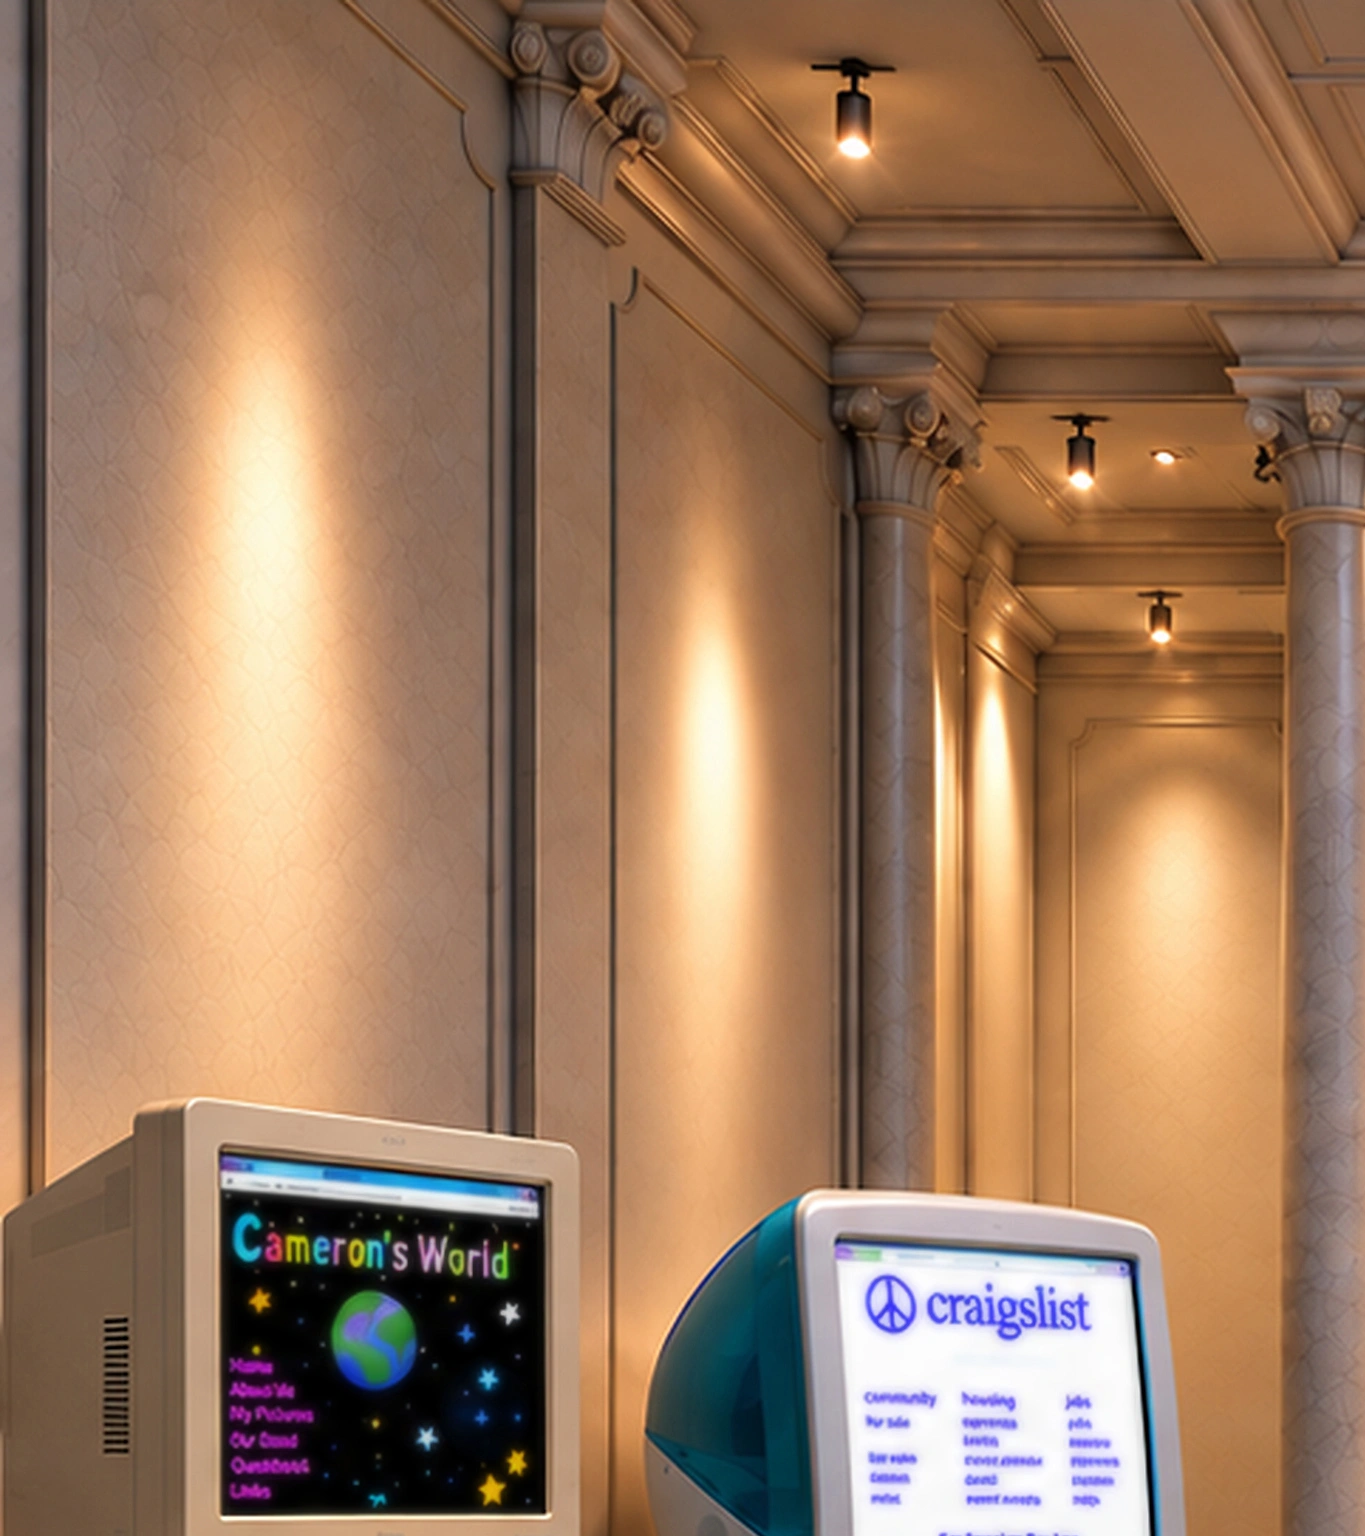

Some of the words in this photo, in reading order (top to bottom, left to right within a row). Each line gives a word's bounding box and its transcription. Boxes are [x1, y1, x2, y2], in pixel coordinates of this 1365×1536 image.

[232, 1213, 408, 1271] Cameron's
[418, 1234, 509, 1280] World
[926, 1283, 1091, 1341] craigslist
[864, 1391, 936, 1408] Community
[962, 1392, 1016, 1412] housing
